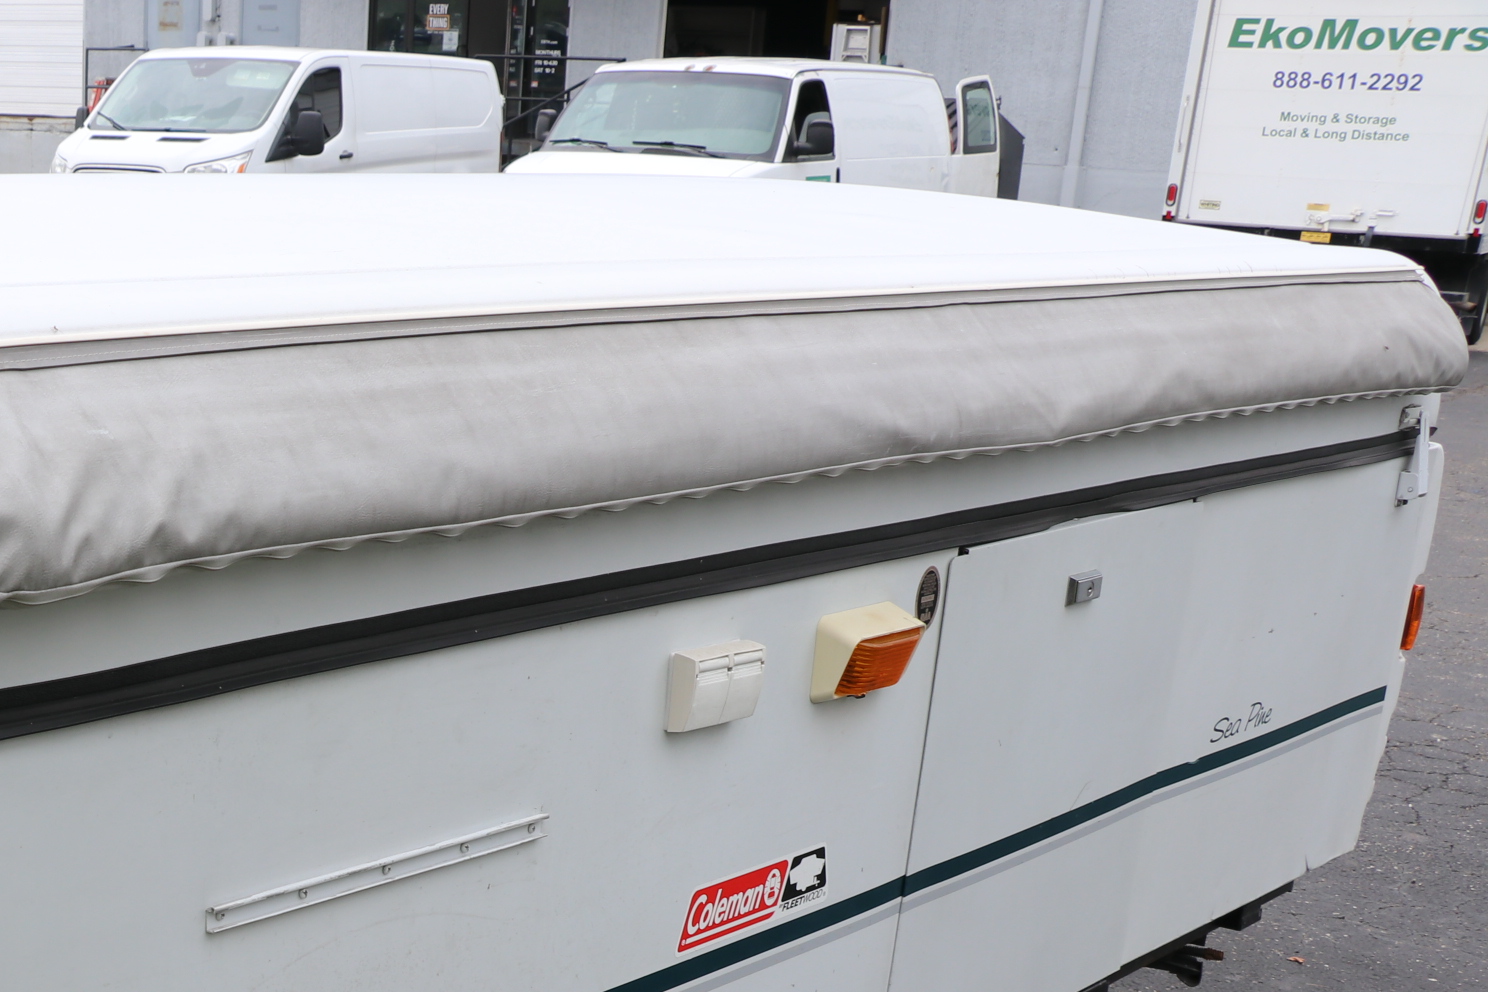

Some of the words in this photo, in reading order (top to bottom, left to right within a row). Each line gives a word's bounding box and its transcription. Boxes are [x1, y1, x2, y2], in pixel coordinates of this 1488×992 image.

[429, 3, 449, 15] EVERY
[429, 17, 448, 28] THING
[1226, 18, 1488, 52] EkoMovers
[1272, 71, 1423, 91] 888-611-2292
[1279, 111, 1327, 126] Moving
[1331, 113, 1340, 124] &
[1344, 113, 1397, 127] Storage
[1261, 126, 1296, 138] Local
[1300, 127, 1310, 139] &
[1313, 128, 1347, 142] Long
[1351, 129, 1410, 142] Distance
[1209, 716, 1242, 743] Sea
[1244, 701, 1273, 731] Pine
[686, 883, 765, 935] Coleman
[781, 888, 824, 912] FLEETWOOD
